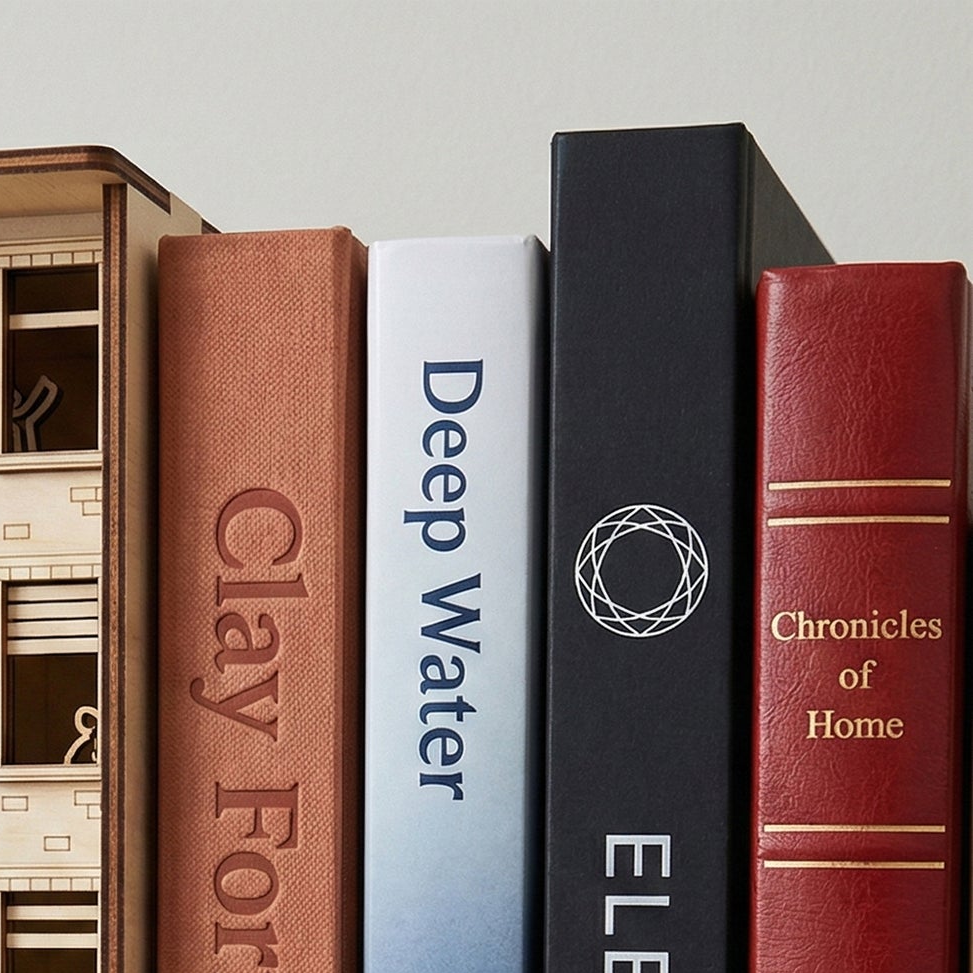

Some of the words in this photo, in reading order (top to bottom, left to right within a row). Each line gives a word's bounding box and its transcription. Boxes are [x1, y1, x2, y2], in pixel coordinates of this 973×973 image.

[403, 359, 483, 552] Deep
[189, 487, 309, 742] Clay
[771, 610, 943, 640] Chronicles
[418, 573, 481, 801] Water
[806, 710, 904, 740] Home
[838, 660, 878, 690] of
